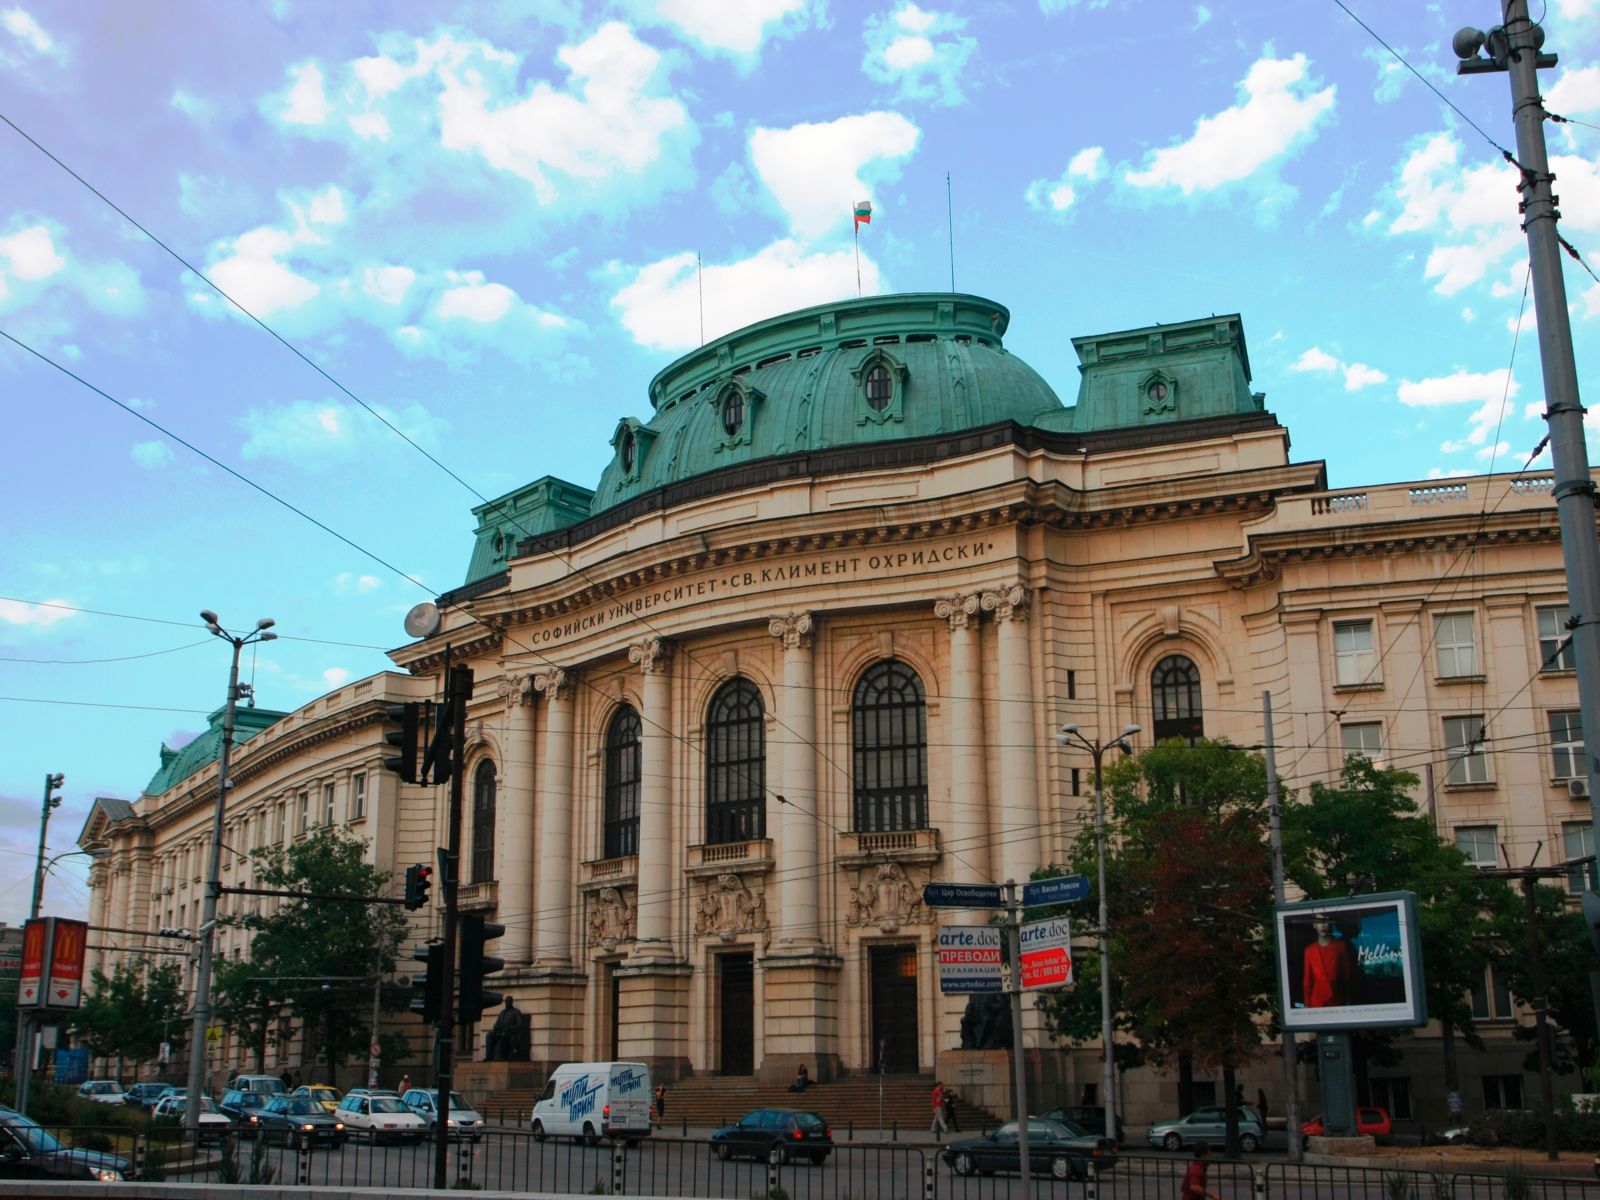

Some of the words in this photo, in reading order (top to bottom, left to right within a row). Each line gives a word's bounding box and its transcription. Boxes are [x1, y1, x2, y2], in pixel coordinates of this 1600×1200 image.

[532, 612, 604, 644] СОФИЙСКИ
[609, 579, 718, 621] УНИВЕРСИТЕТ
[761, 558, 861, 582] КЛИМЕНТ
[869, 542, 985, 569] ОХРИДСКИ
[940, 930, 999, 946] arte.doc
[1021, 921, 1068, 943] arte.doc
[940, 951, 1000, 963] ПРЕВОДИ
[942, 980, 1001, 989] www.artedoc.com
